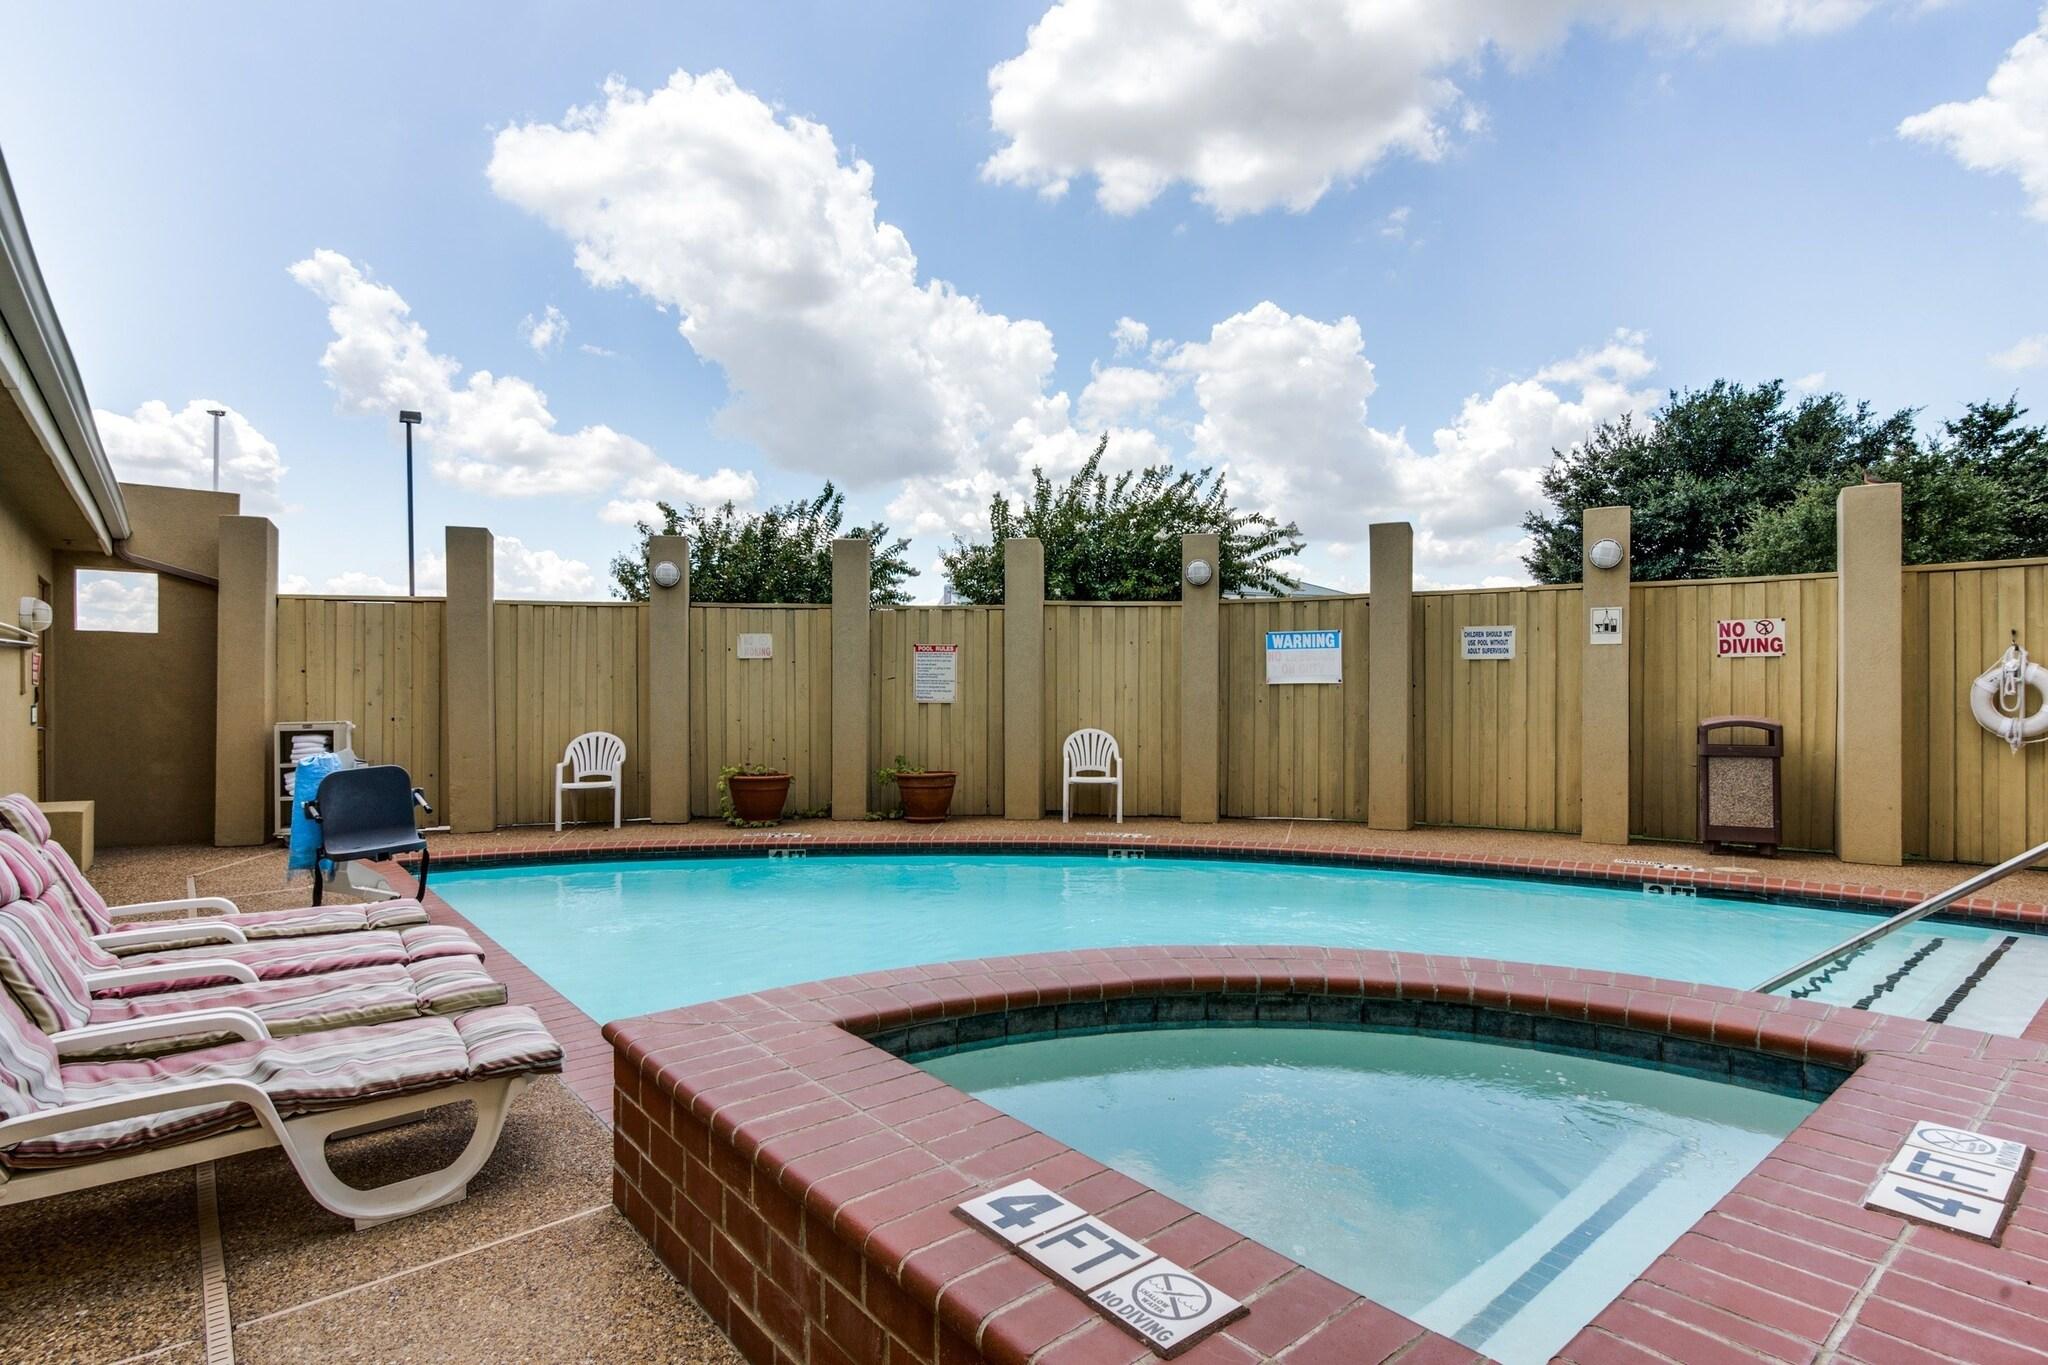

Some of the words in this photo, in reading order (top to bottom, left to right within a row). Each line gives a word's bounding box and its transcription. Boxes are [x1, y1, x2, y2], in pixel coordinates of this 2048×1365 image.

[1720, 622, 1745, 638] NO
[1272, 633, 1335, 649] WARNING
[1719, 637, 1783, 654] DIVING
[741, 647, 771, 657] MOKING
[1906, 1151, 1996, 1193] FT
[1894, 1186, 1981, 1217] 4
[986, 1194, 1064, 1230] 4
[1035, 1223, 1141, 1274] FT
[1139, 1288, 1170, 1309] SHALLOW
[1141, 1297, 1166, 1314] WATER
[1096, 1290, 1124, 1308] NO
[1117, 1303, 1174, 1342] DIVING
